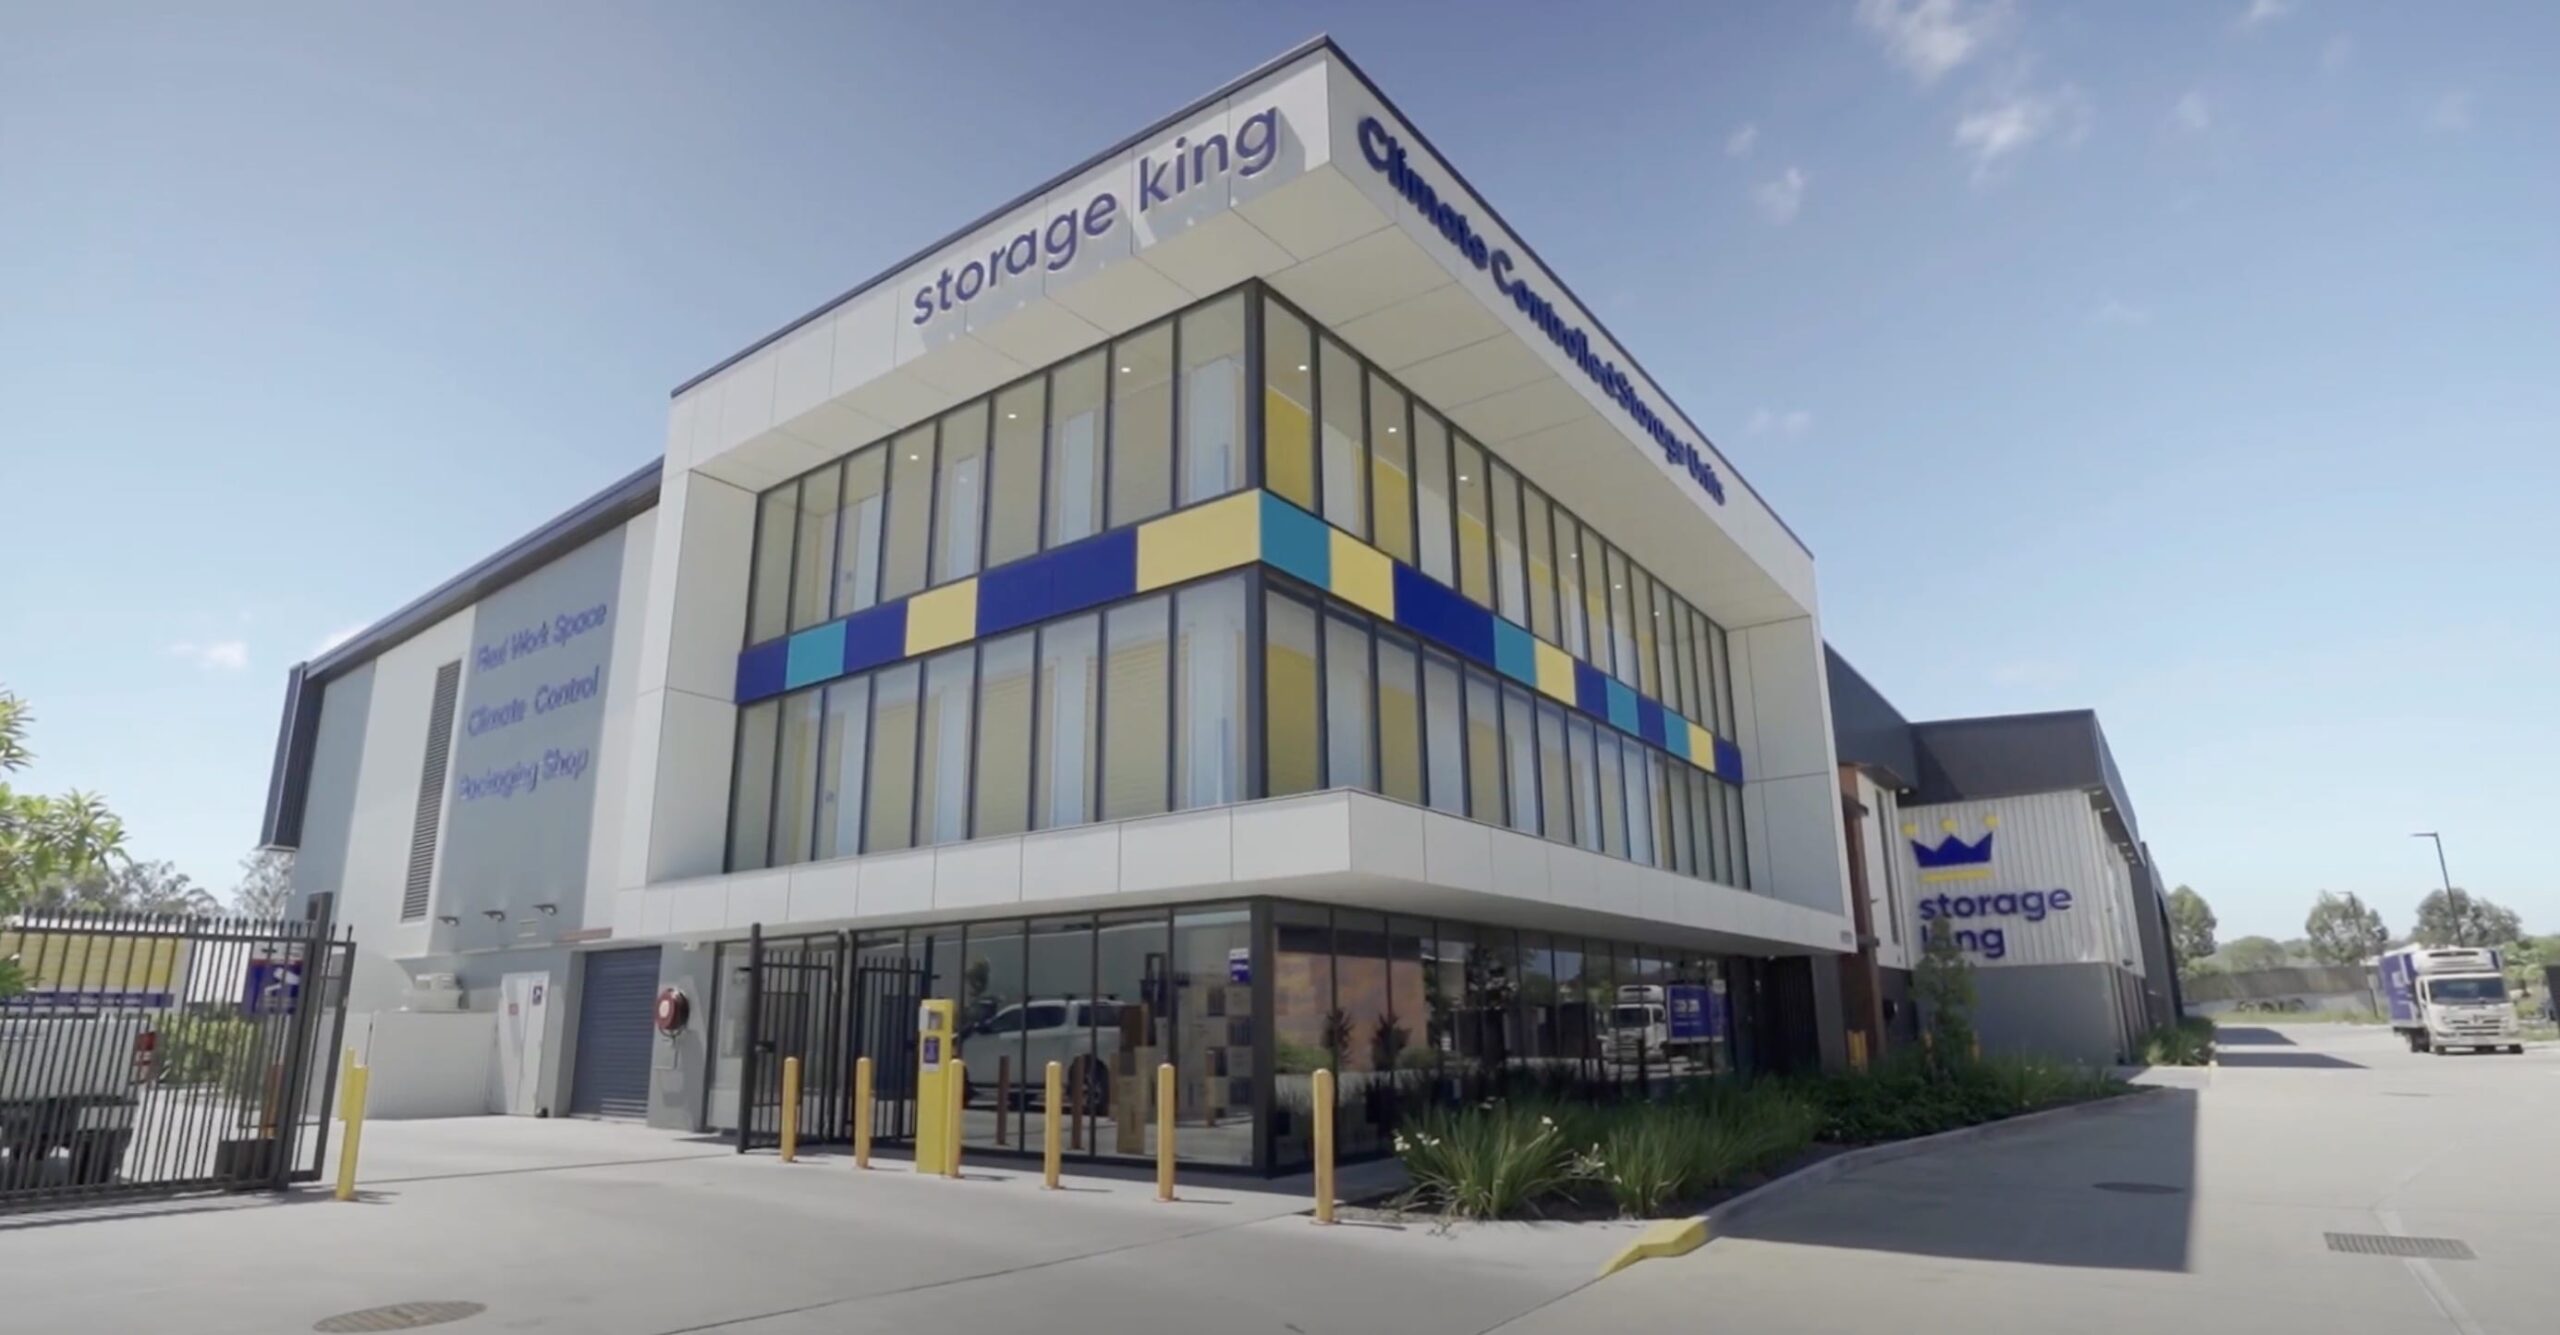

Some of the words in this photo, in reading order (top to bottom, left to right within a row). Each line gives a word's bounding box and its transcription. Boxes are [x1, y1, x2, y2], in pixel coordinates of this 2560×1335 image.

[912, 192, 1117, 325] storage
[1138, 106, 1278, 213] king
[1357, 116, 1488, 270] Climate
[1490, 249, 1620, 399] Controlled
[1616, 372, 1686, 466] Storage
[1685, 442, 1725, 506] Units
[553, 604, 607, 647] Space
[535, 664, 600, 715] Control
[543, 748, 589, 781] Shop
[1919, 889, 2073, 922] storage
[1920, 924, 2006, 960] ng
